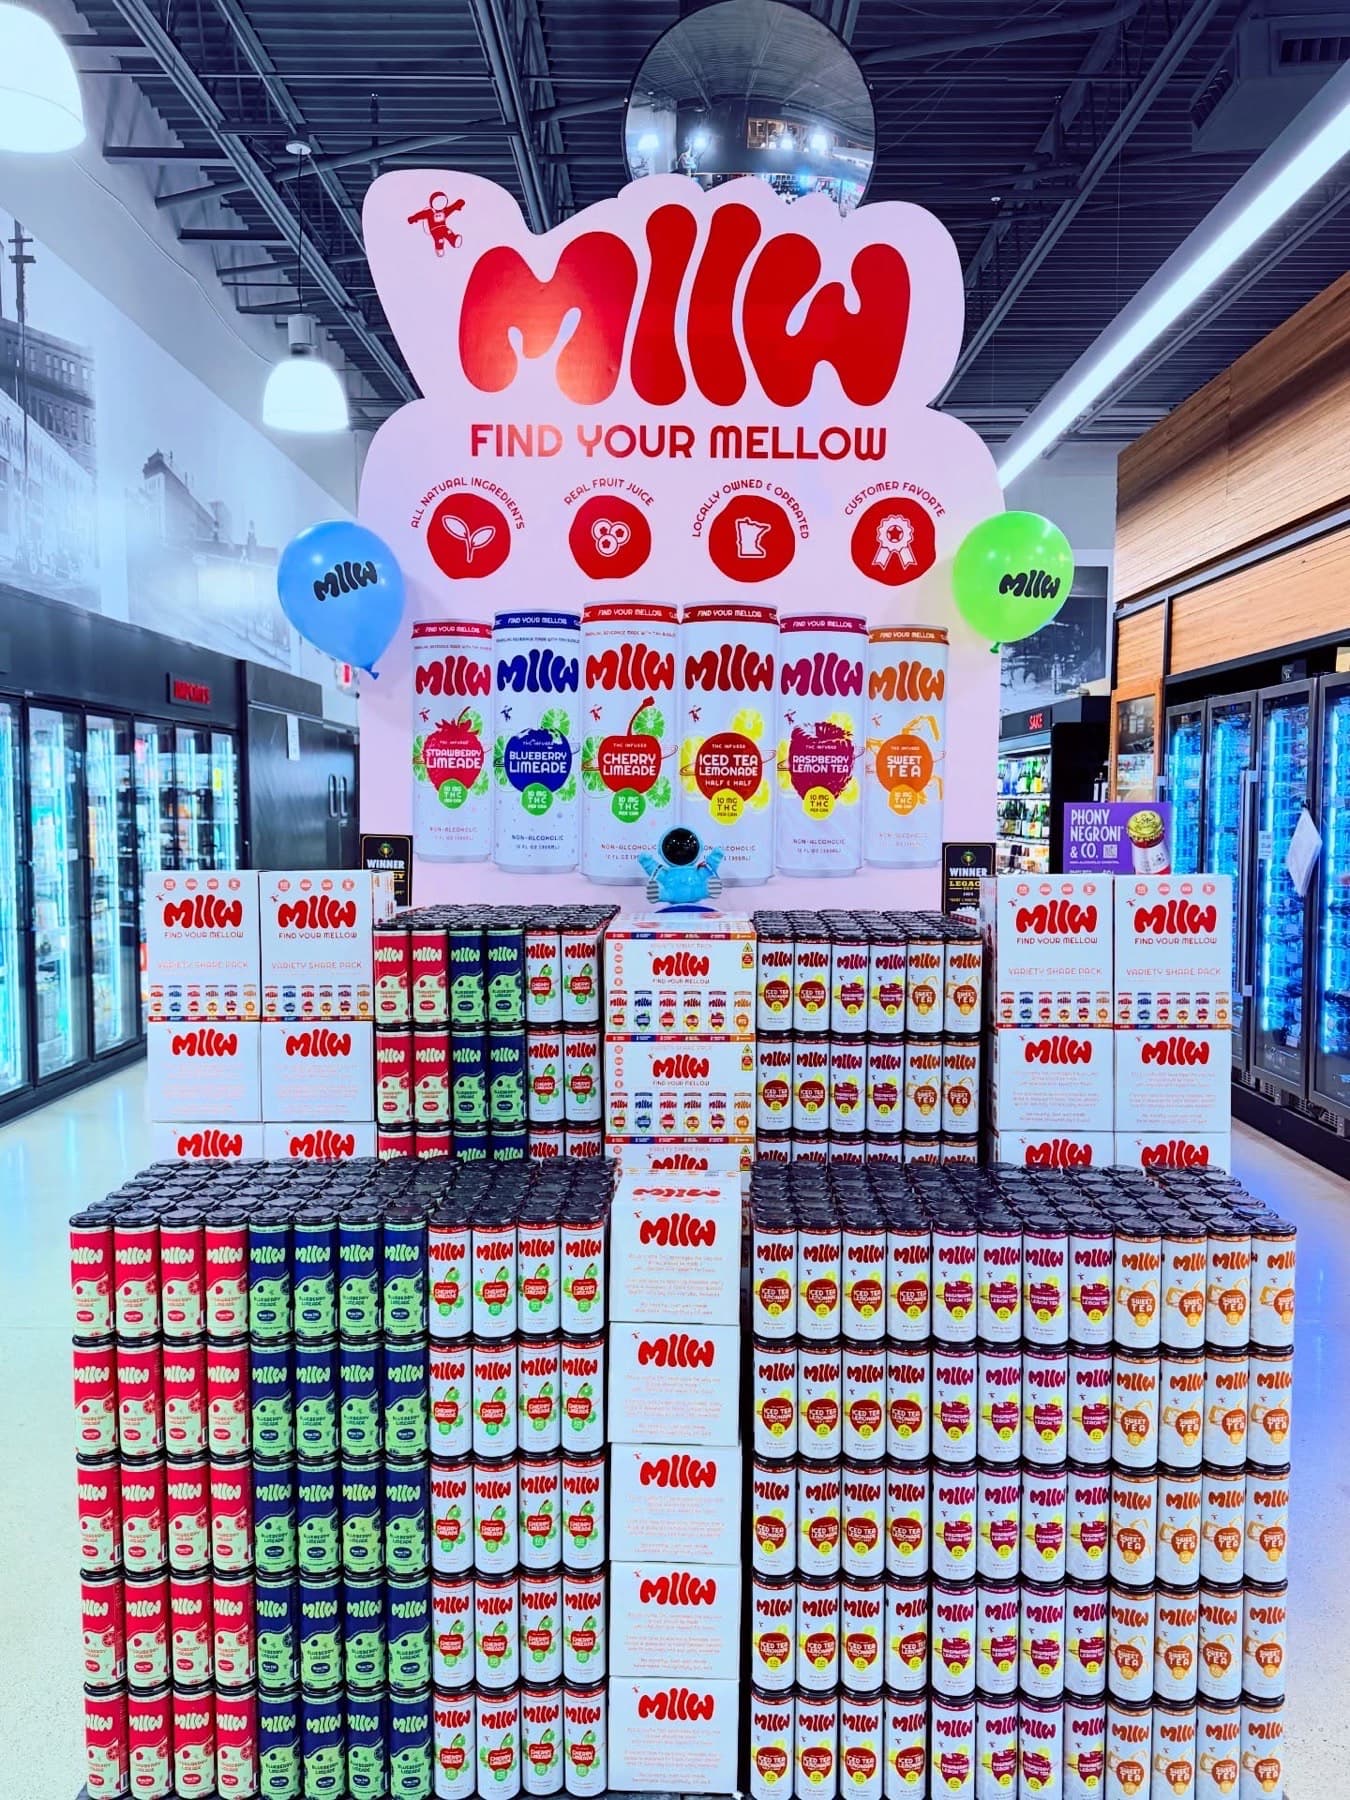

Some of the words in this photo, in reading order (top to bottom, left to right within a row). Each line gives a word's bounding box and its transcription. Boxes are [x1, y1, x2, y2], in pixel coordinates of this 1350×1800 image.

[471, 424, 562, 458] FIND
[576, 424, 695, 459] YOUR
[710, 426, 886, 461] MELLOW
[564, 484, 590, 505] REAL
[592, 478, 625, 488] FRUIT
[626, 483, 654, 506] JUICE
[844, 481, 899, 515] CUSTOMER
[411, 509, 424, 528] ALL
[420, 477, 468, 507] NATURAL
[471, 477, 525, 529] INGREDIENTS
[692, 490, 720, 537] LOCALLY
[723, 479, 762, 493] OWNED
[774, 487, 809, 539] OPERATED
[697, 610, 712, 618] FIND
[735, 610, 762, 618] MELLOW
[426, 749, 481, 757] STRAWBERRY
[509, 751, 567, 760] BLUEBERRY
[603, 753, 656, 765] CHERRY
[426, 757, 481, 769] LIMEADE
[699, 754, 729, 766] ICED
[733, 754, 758, 766] TEA
[792, 755, 849, 764] RASPBERRY
[886, 755, 922, 765] SWEET
[509, 761, 567, 773] LIMEADE
[603, 765, 656, 776] LIMEADE
[699, 766, 758, 776] LEMONADE
[792, 764, 828, 773] LEMON
[831, 764, 849, 773] TEA
[887, 765, 921, 777] TEA
[705, 779, 724, 787] HALF
[734, 779, 752, 787] HALF
[1071, 809, 1110, 825] PHONY
[1070, 826, 1121, 841] NEGRONI
[1069, 846, 1078, 858] &
[1081, 843, 1098, 858] CO.
[366, 859, 405, 869] WINNER
[949, 867, 988, 877] WINNER
